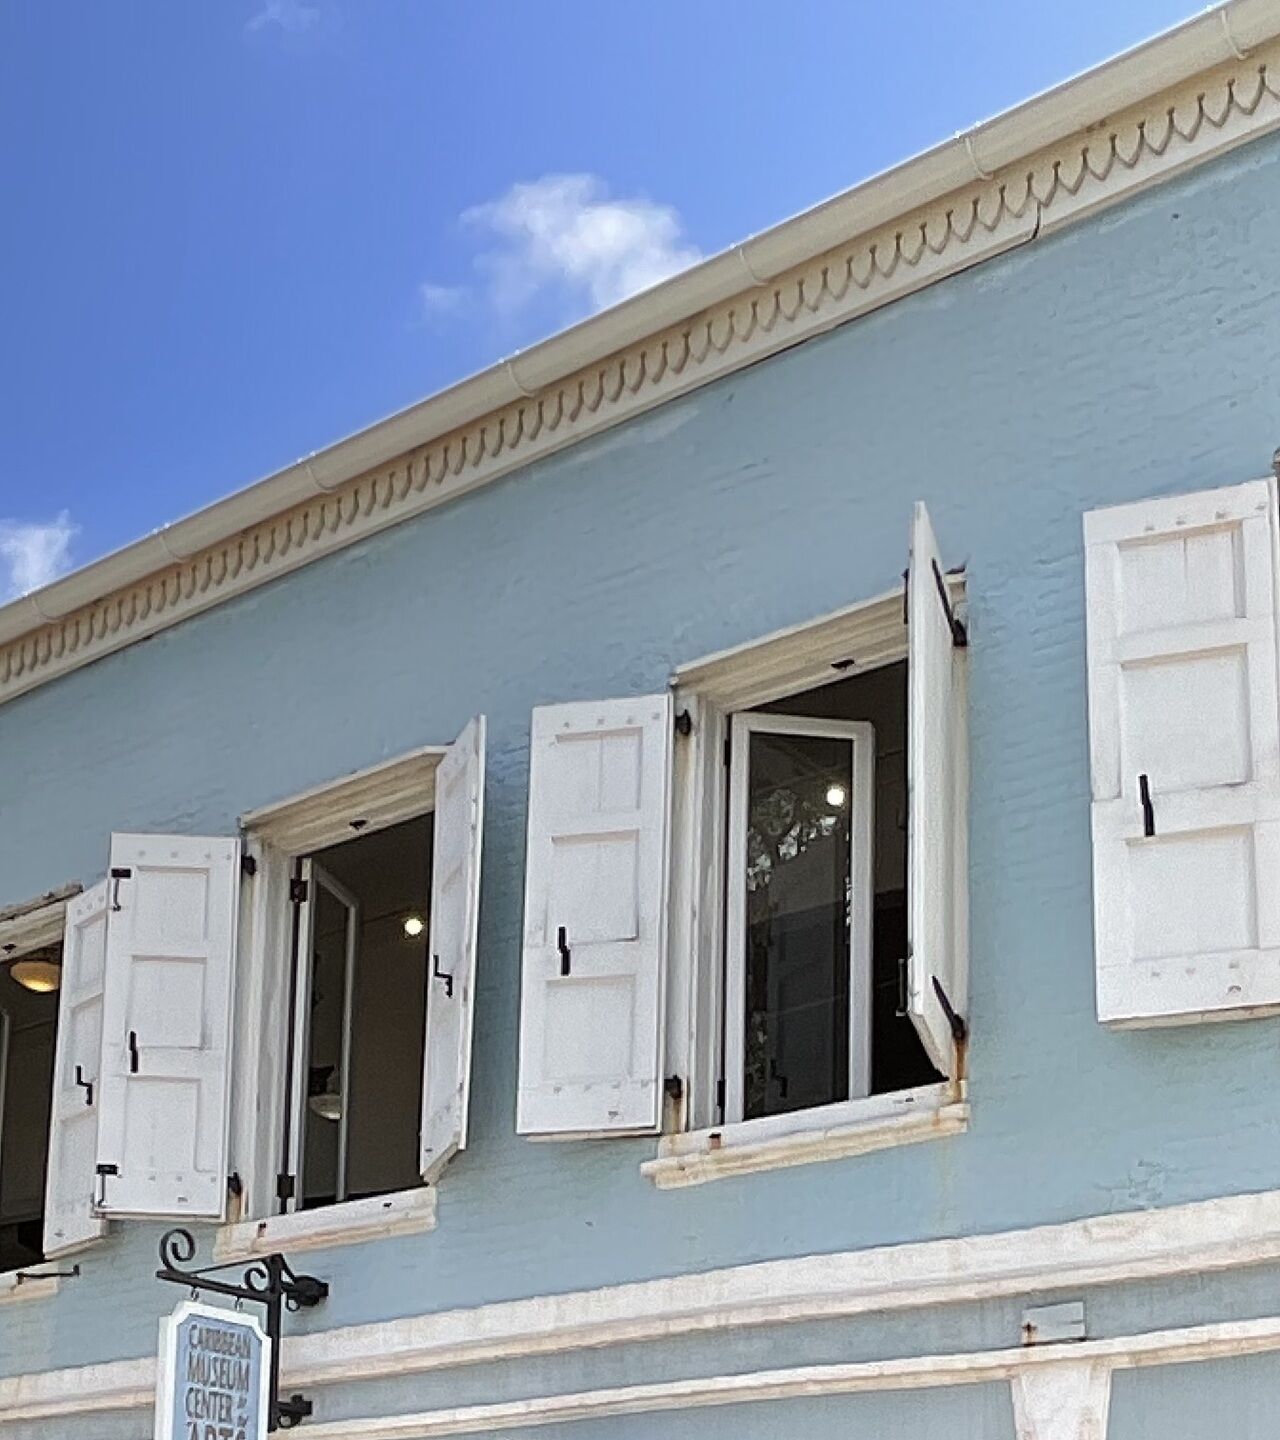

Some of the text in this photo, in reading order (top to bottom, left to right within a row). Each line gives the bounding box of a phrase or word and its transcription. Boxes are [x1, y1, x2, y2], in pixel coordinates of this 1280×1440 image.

[188, 1323, 251, 1360] CARIBBEAN
[187, 1353, 250, 1394] MUSEUM
[185, 1386, 233, 1424] CENTER
